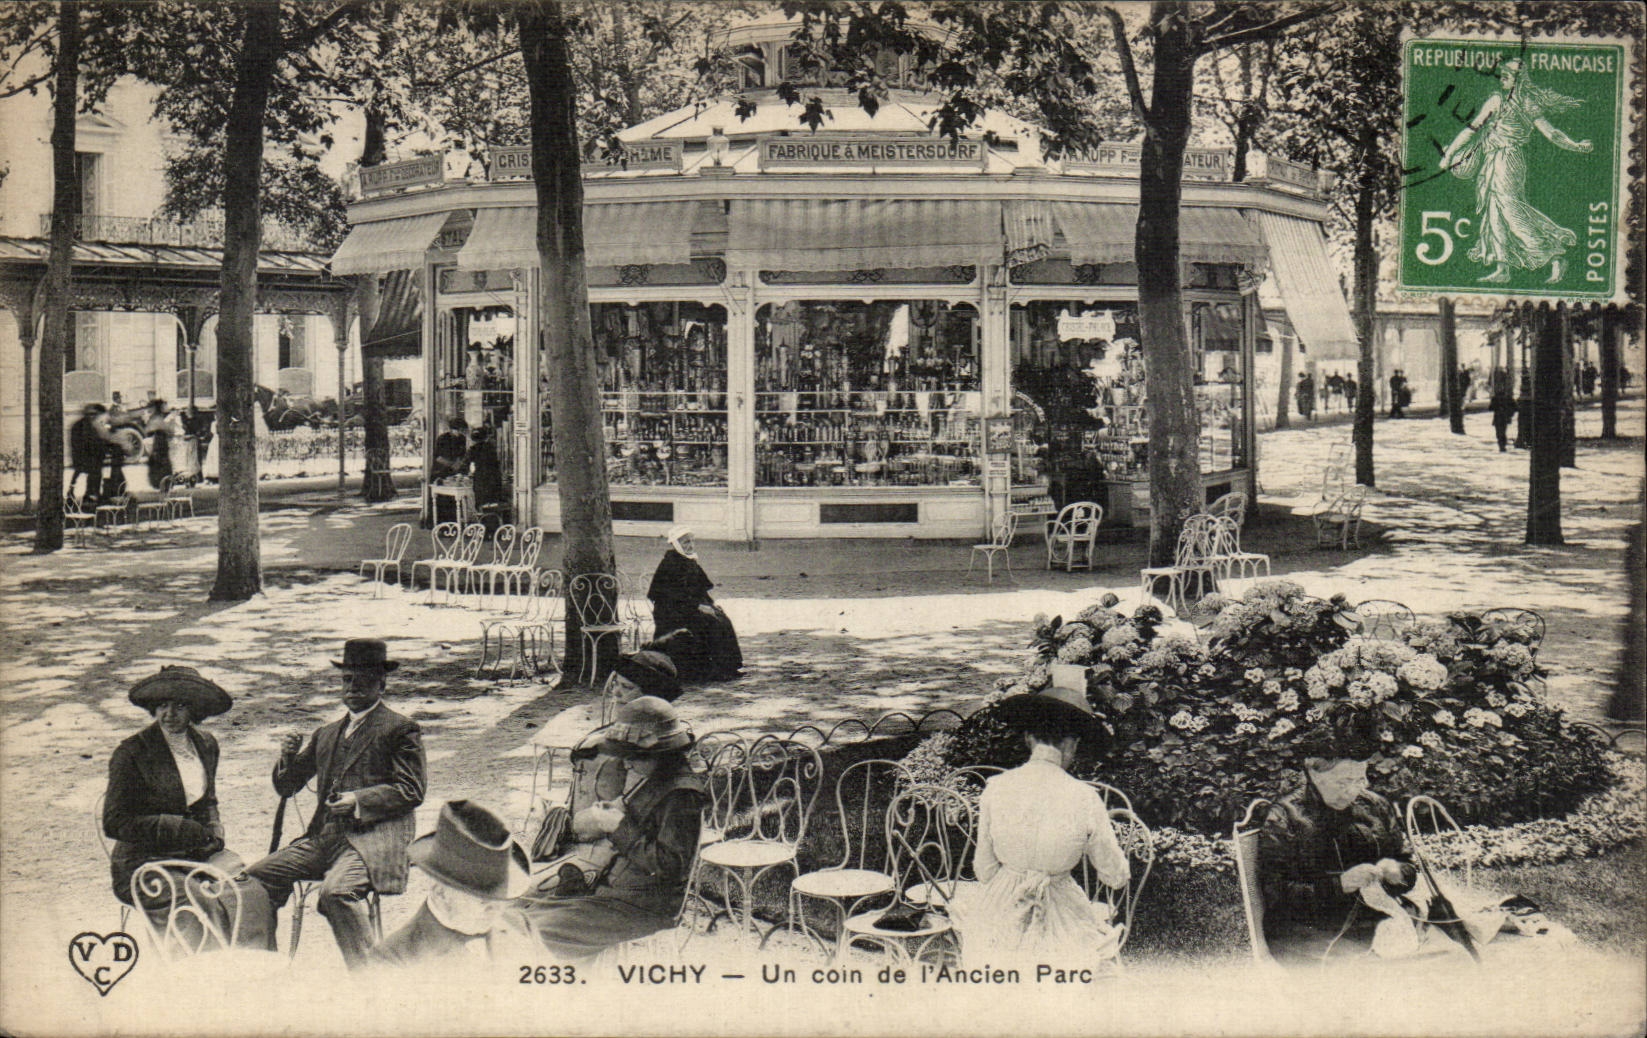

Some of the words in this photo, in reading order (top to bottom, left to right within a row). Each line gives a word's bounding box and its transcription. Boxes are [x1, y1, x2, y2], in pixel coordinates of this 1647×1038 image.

[1531, 53, 1613, 73] FRANÇAISE
[768, 144, 841, 160] FABRIQUE
[857, 144, 978, 160] MEISTERSDORF
[1586, 202, 1608, 282] POSTES
